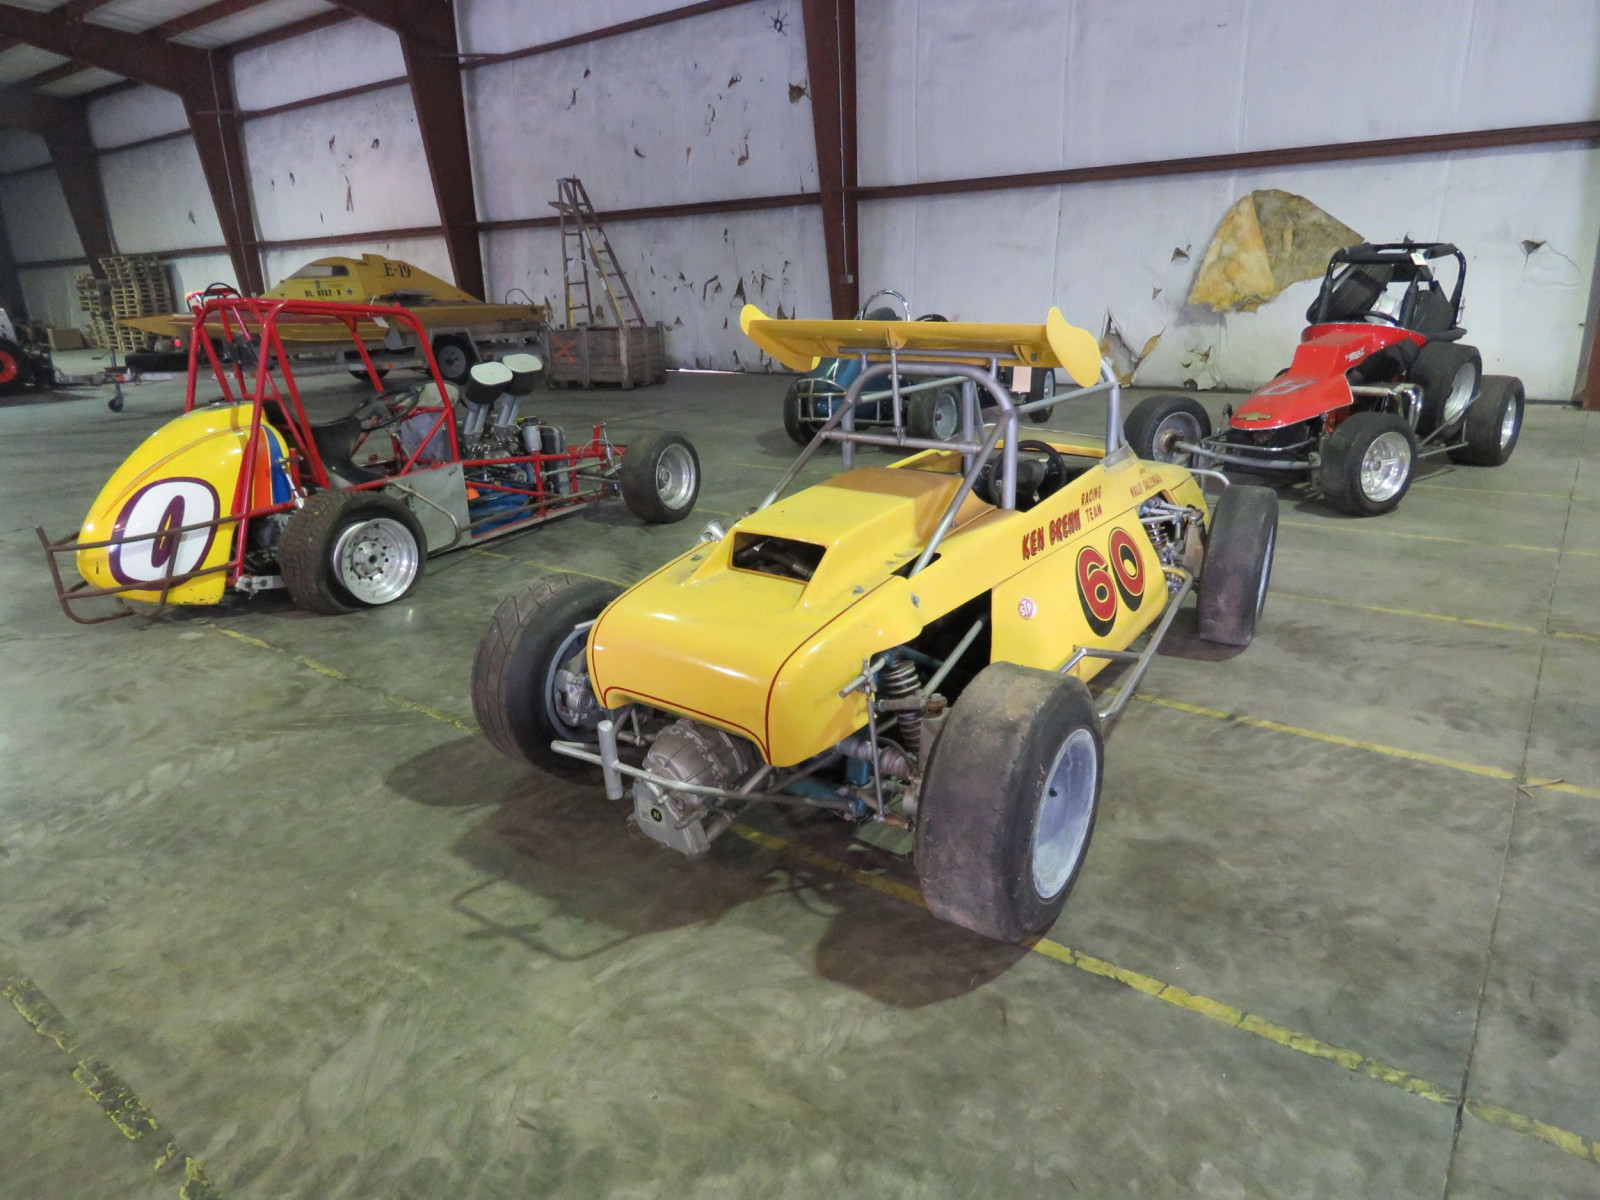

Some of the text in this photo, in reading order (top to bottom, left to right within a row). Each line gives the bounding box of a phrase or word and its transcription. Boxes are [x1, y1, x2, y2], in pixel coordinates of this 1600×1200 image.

[384, 262, 411, 278] E-19
[1081, 485, 1102, 506] RACING
[1085, 503, 1103, 523] TEAM
[109, 476, 221, 591] 0
[1022, 508, 1081, 561] KEN BRENN
[1075, 526, 1145, 637] 60
